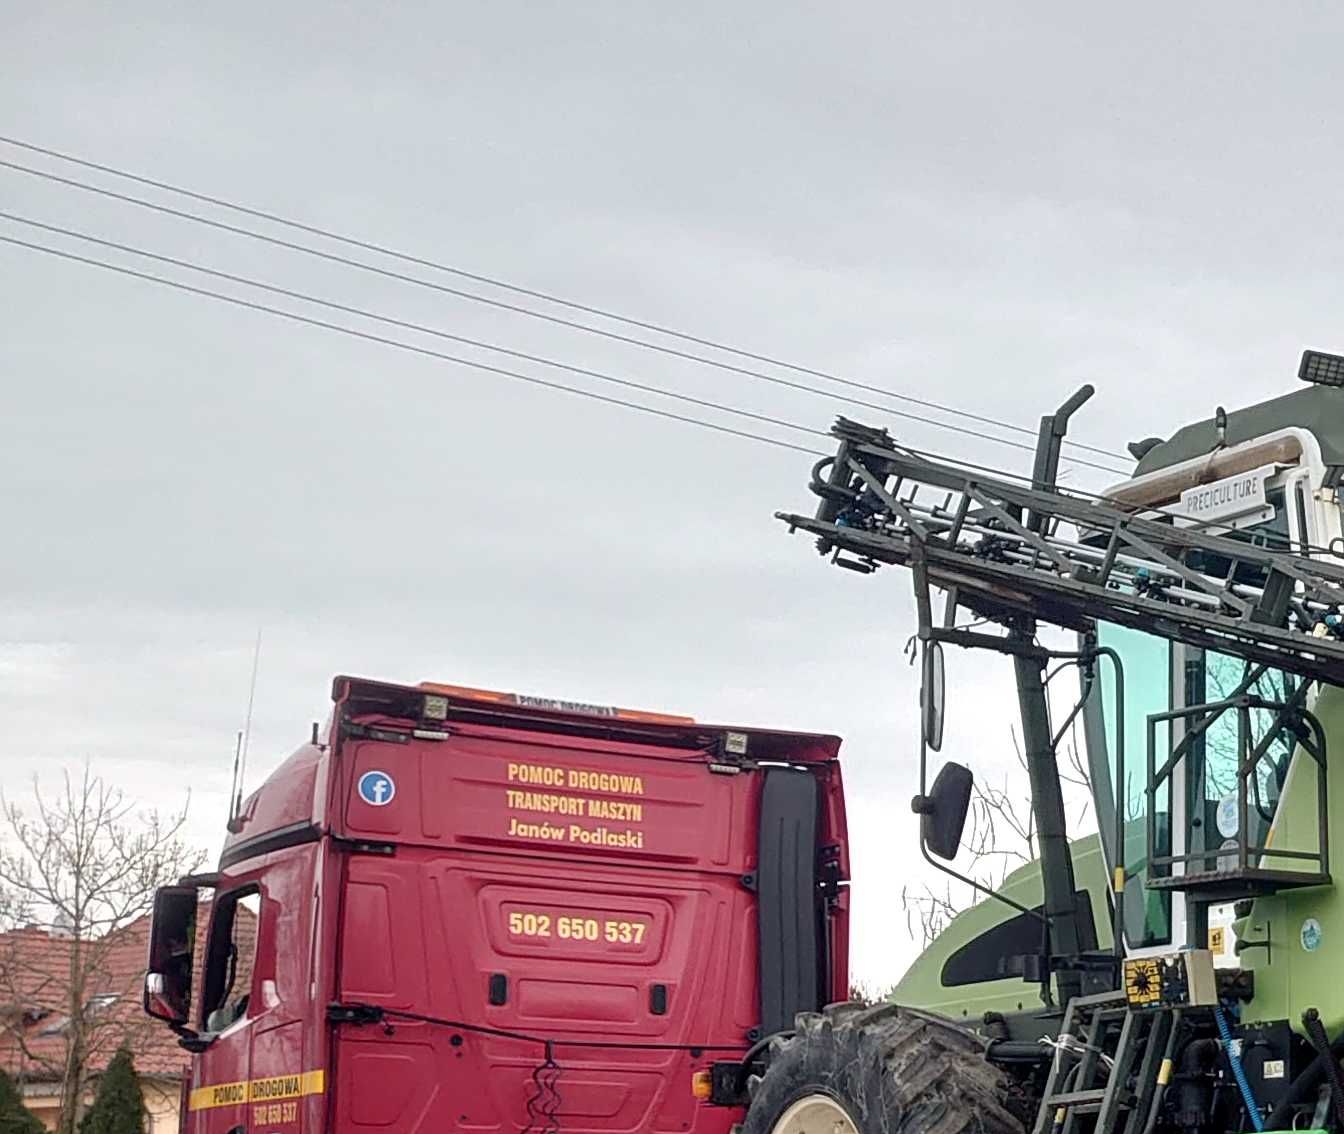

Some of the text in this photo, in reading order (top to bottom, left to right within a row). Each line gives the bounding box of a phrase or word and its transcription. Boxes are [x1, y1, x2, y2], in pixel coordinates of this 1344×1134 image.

[1187, 476, 1257, 513] PRECICULTURE
[508, 763, 644, 795] POMOC DROGOWA
[506, 790, 642, 821] TRANSPORT MASZYN
[508, 818, 643, 849] Janów Podlaski
[509, 912, 646, 944] 502 650 537
[213, 1077, 300, 1105] POMOC DROGOWA
